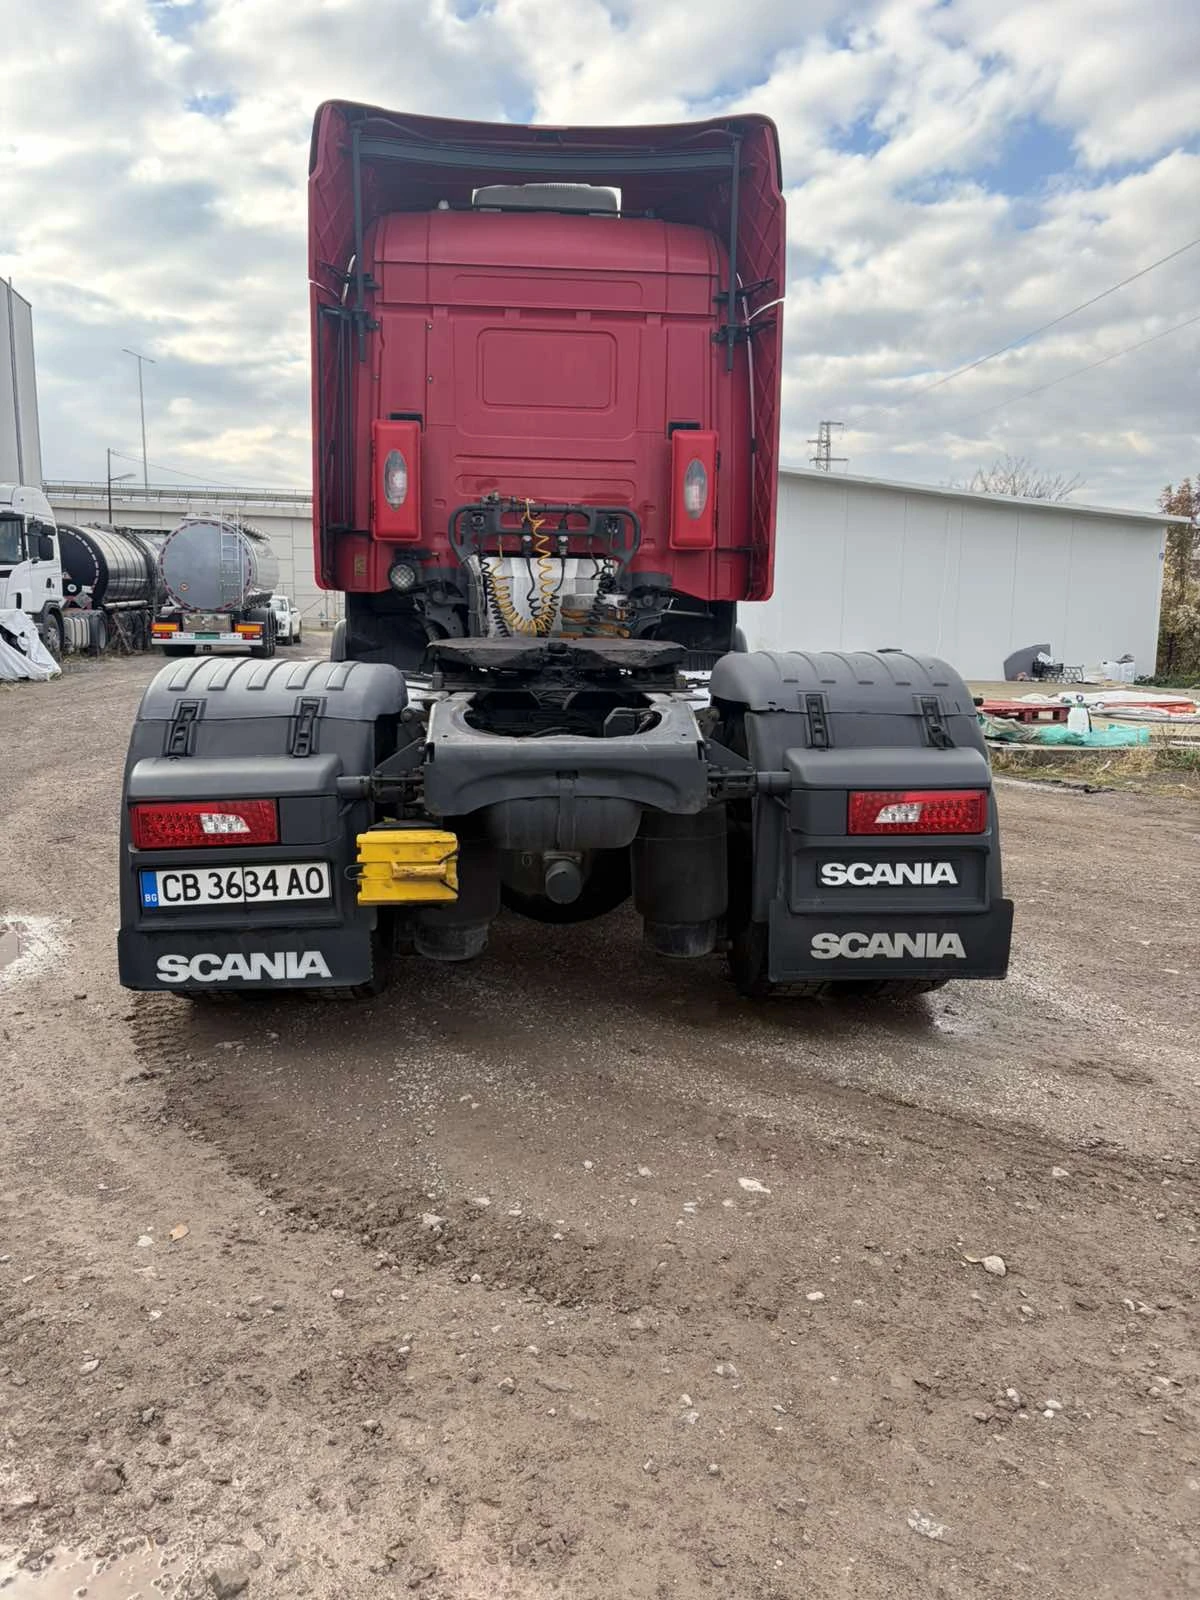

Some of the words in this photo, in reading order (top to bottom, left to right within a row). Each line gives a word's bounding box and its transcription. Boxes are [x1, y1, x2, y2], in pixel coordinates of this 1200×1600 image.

[162, 873, 201, 902] CB
[207, 869, 279, 900] 3634
[820, 862, 959, 886] SCANIA
[144, 892, 157, 903] BG
[810, 932, 967, 960] SCANIA
[156, 950, 333, 983] SCANIA
